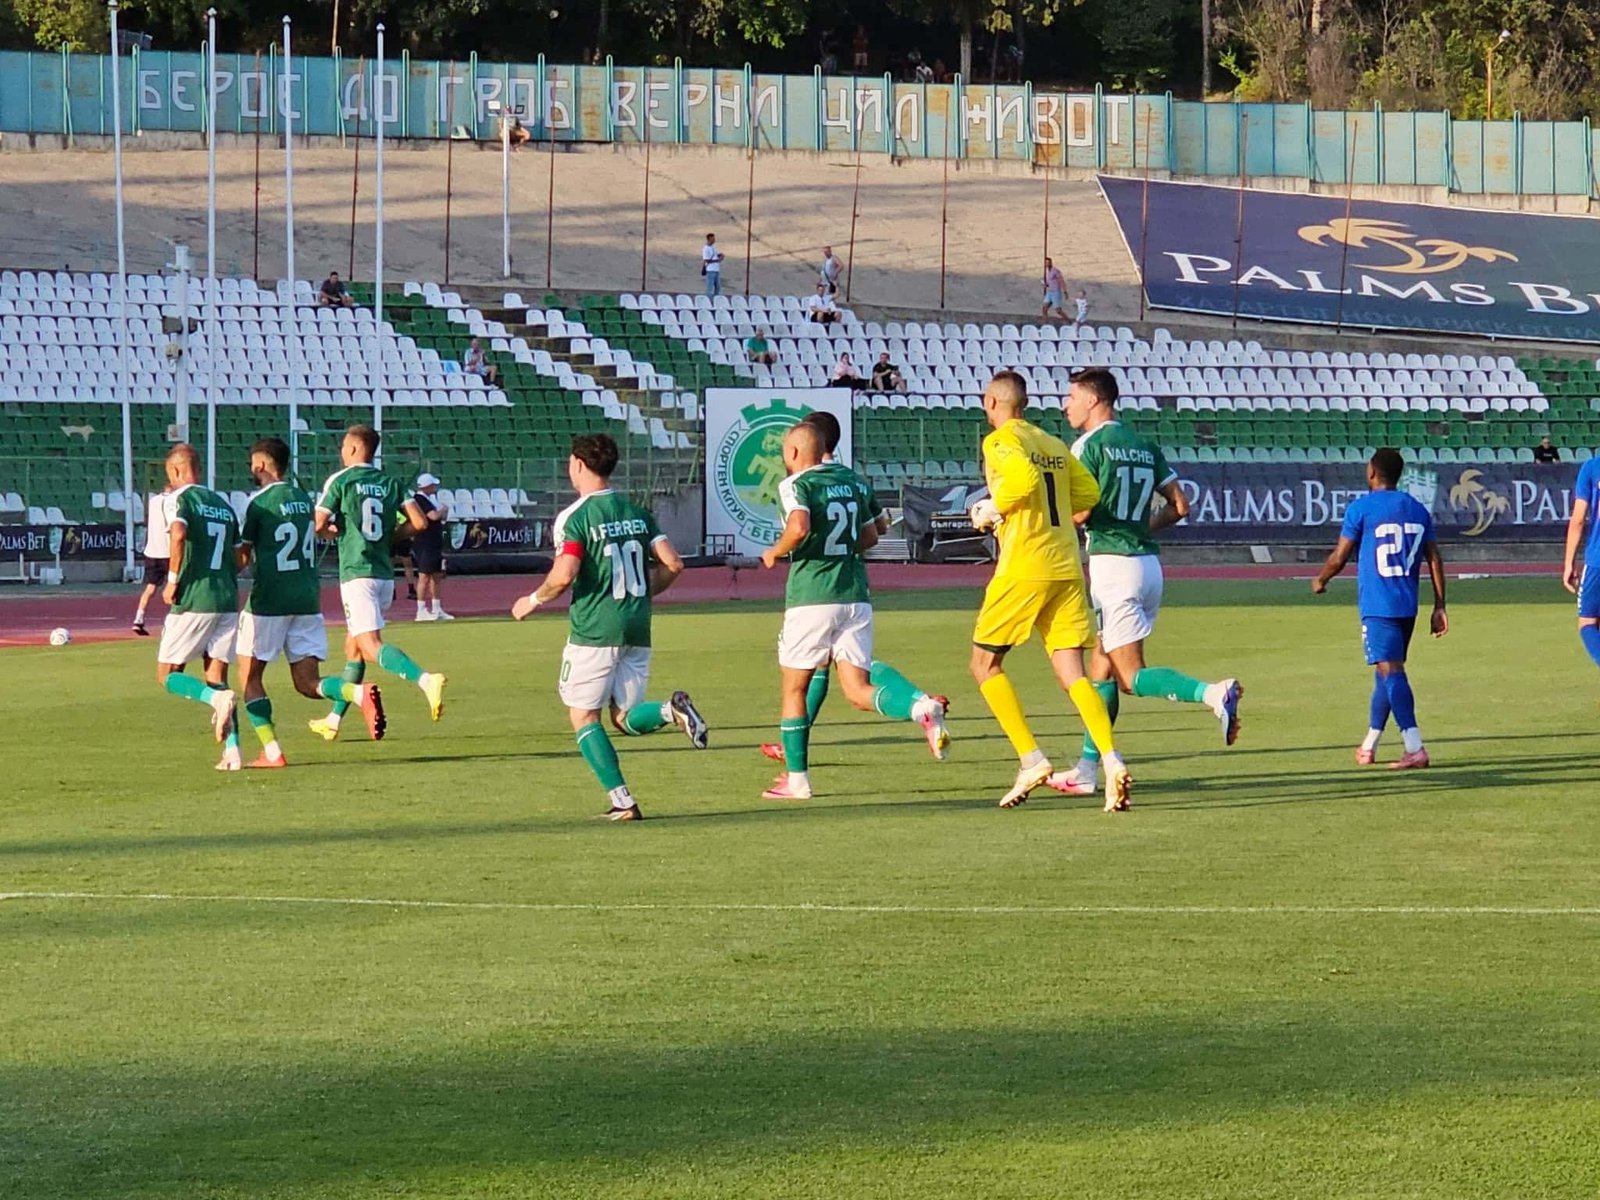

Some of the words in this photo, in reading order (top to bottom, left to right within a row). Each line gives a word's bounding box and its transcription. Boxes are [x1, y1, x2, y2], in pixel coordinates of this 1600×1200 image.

[343, 73, 398, 123] ДО
[439, 76, 571, 129] ГРОБ
[612, 81, 778, 128] ВЕРНИ
[821, 88, 918, 142] ЦЯЛ
[962, 95, 1129, 147] ЖИВОТ
[1163, 251, 1496, 306] PALMS
[1508, 281, 1600, 315] B
[718, 430, 740, 487] СПОРТЕН
[721, 488, 746, 521] КЛУБ
[1043, 472, 1060, 527] 1
[1116, 466, 1154, 520] 17
[1512, 480, 1574, 526] PAL
[28, 531, 46, 551] BET
[82, 531, 114, 549] PALMS
[114, 530, 127, 549] BE
[362, 497, 383, 541] 6
[488, 526, 523, 544] PALMS
[751, 526, 783, 542] БЕР
[824, 501, 858, 556] 21
[207, 522, 226, 570] 7
[274, 521, 314, 572] 24
[604, 540, 647, 600] 10
[1375, 522, 1425, 578] 27
